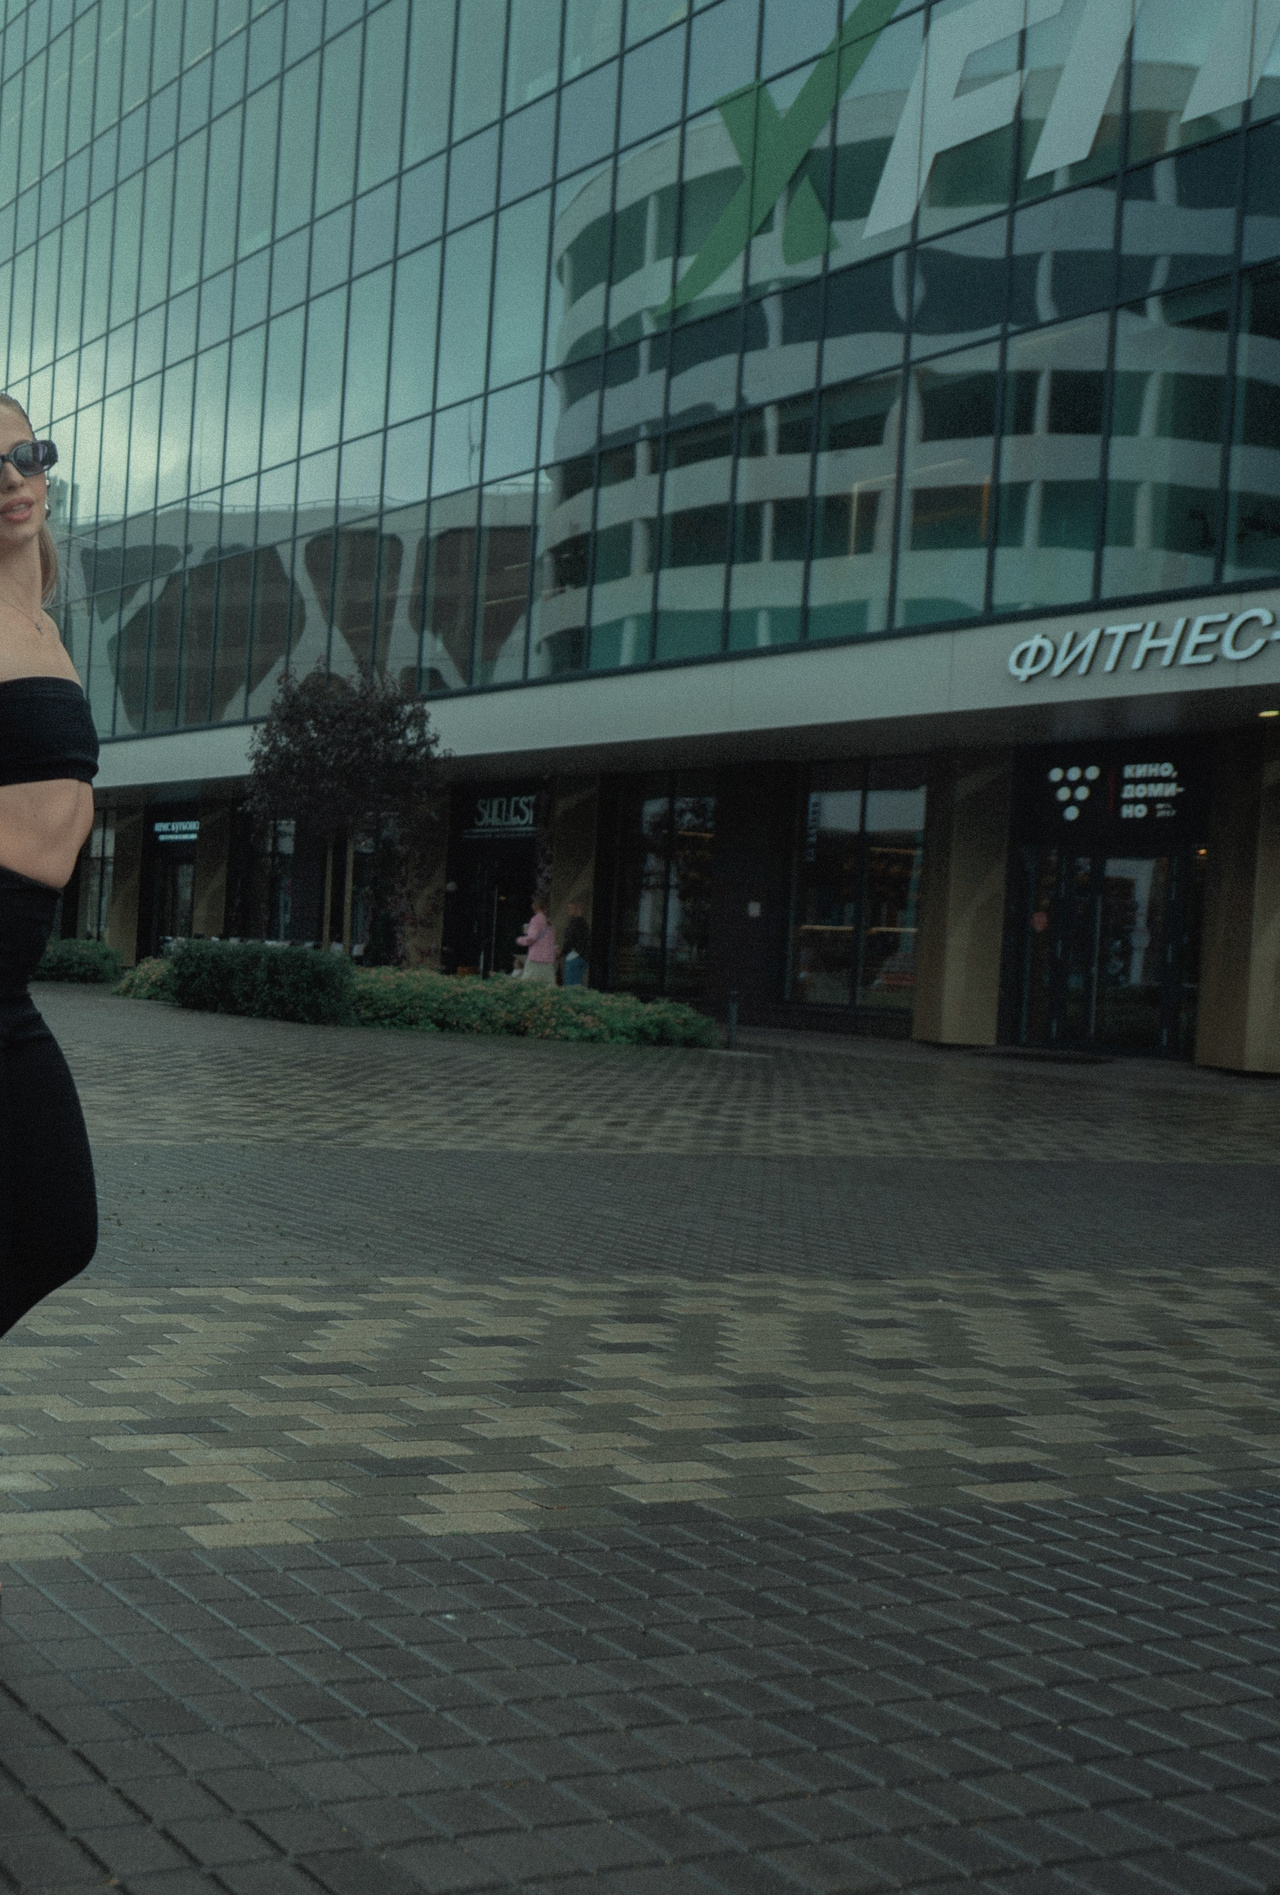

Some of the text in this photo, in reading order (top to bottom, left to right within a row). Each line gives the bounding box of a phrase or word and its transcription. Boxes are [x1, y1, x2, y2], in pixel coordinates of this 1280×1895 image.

[1123, 762, 1178, 779] КИНО,
[1121, 782, 1185, 799] ДОМИ-
[1121, 803, 1148, 819] НО
